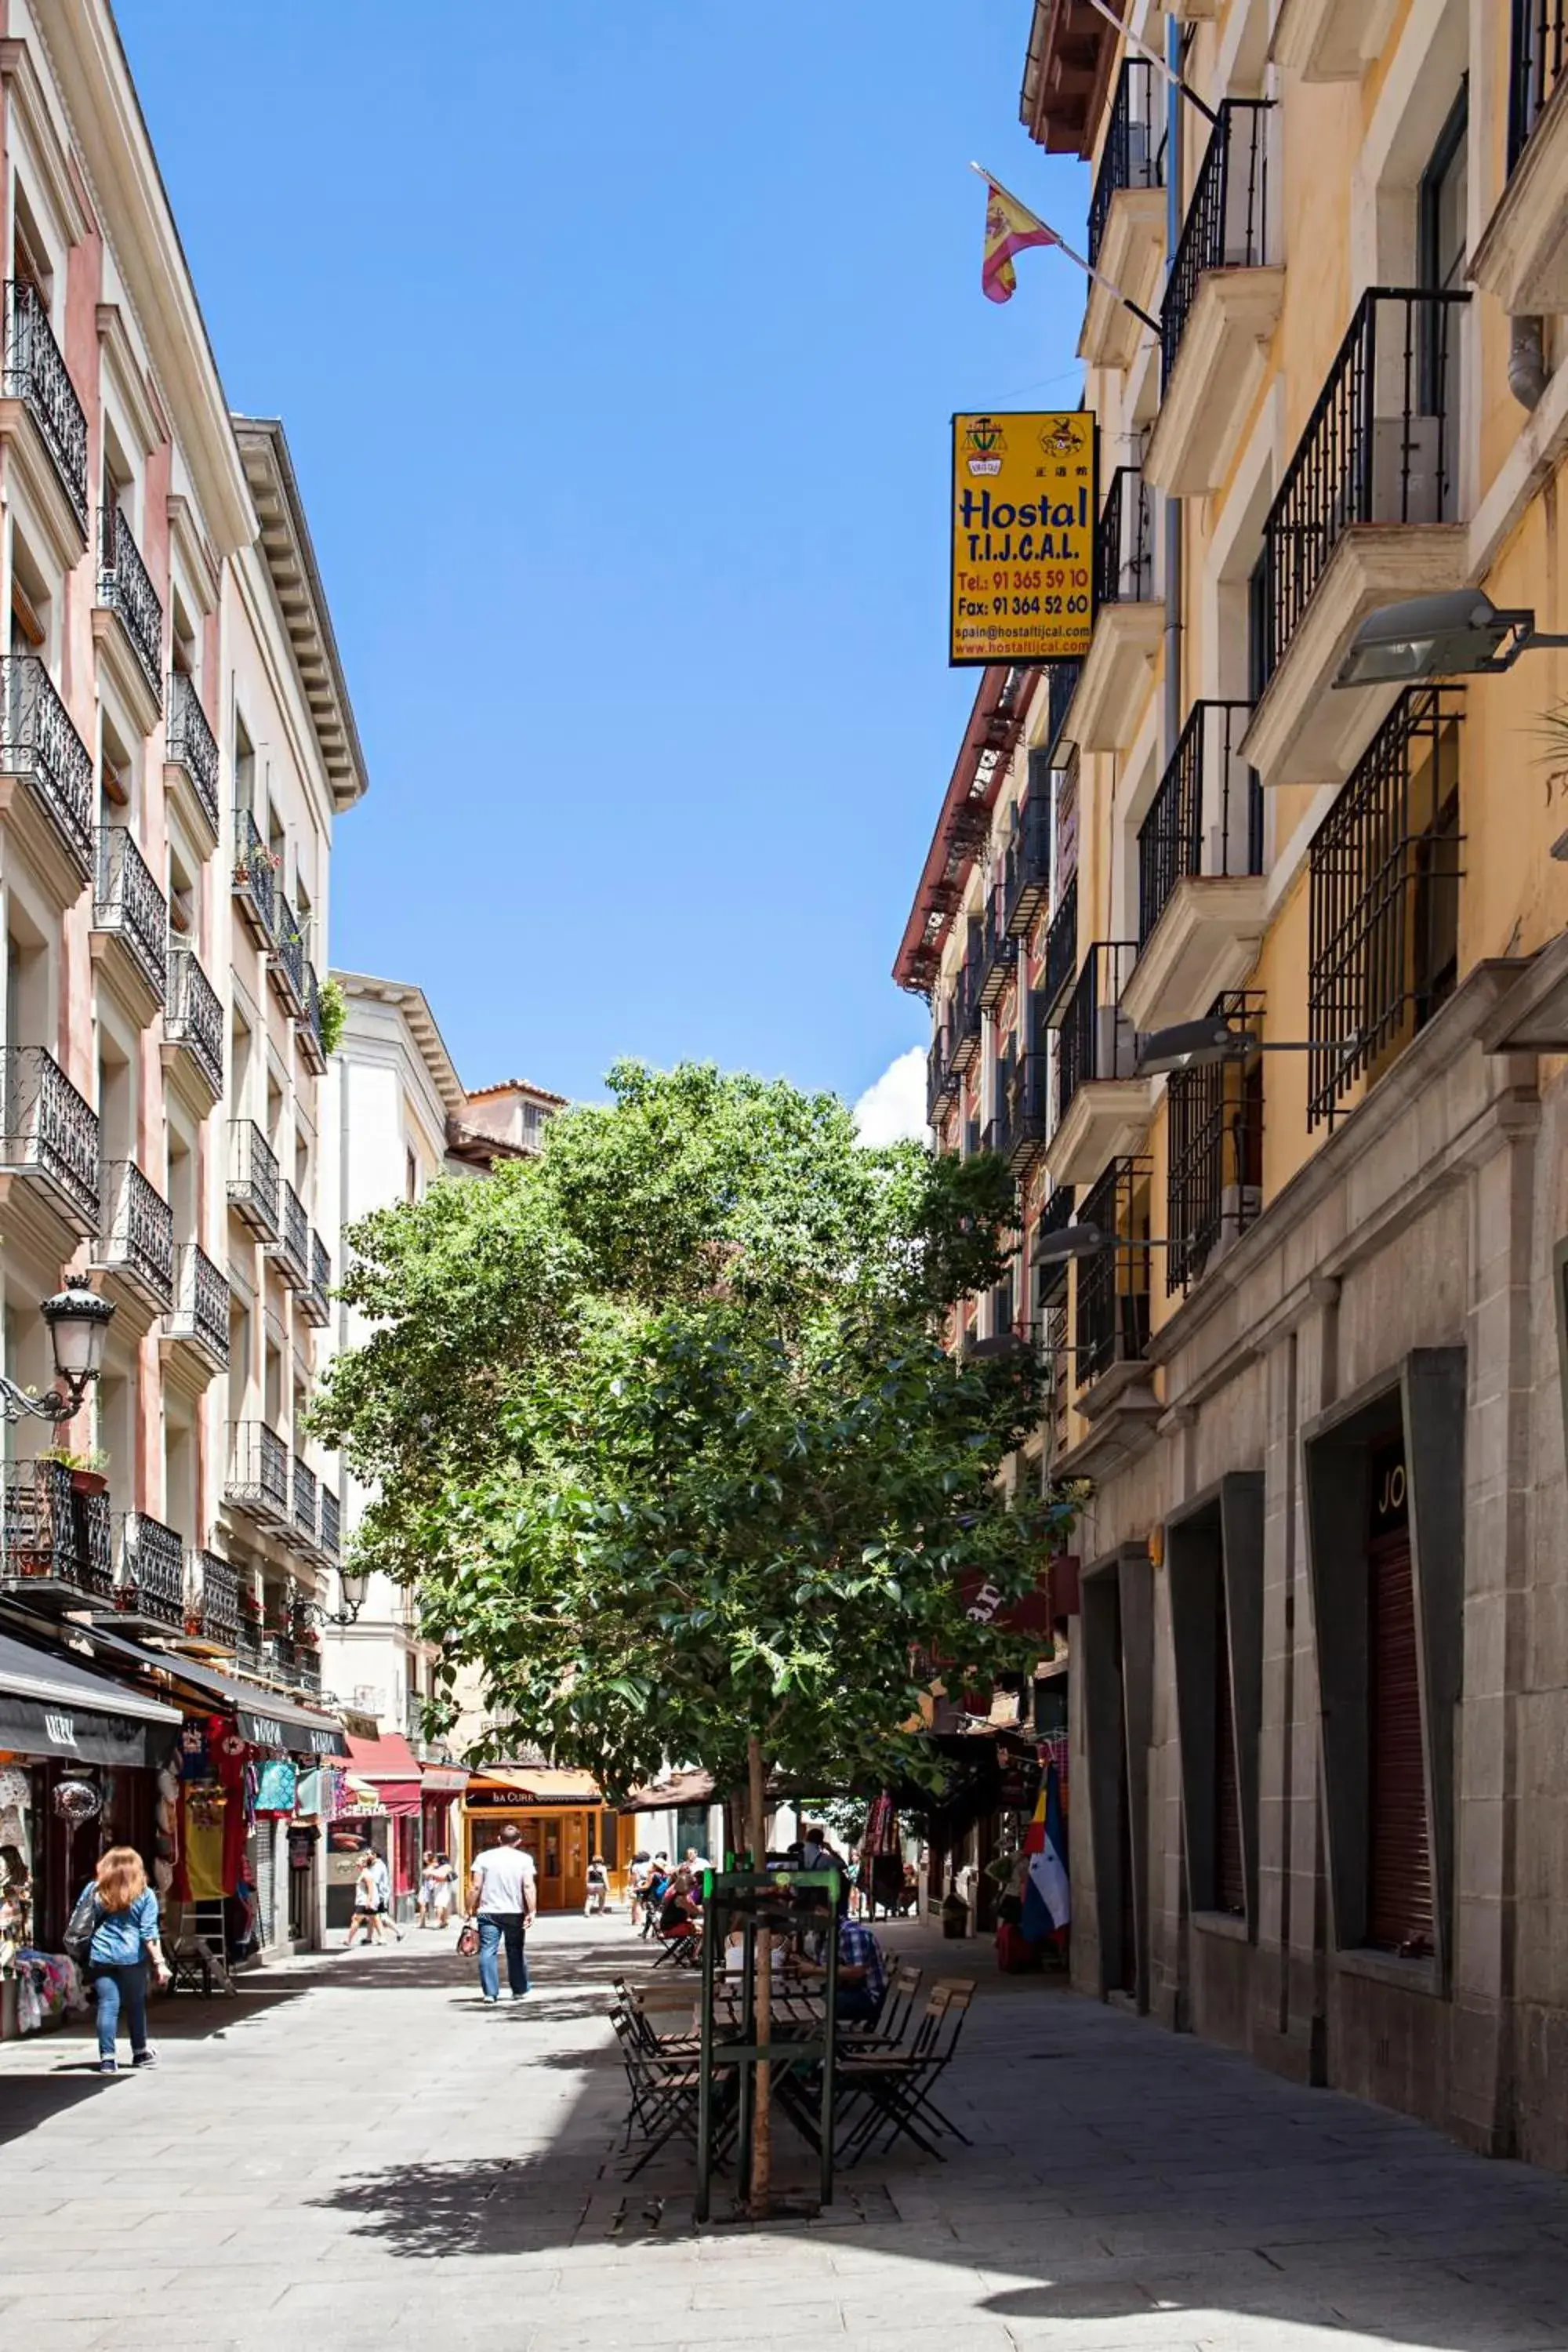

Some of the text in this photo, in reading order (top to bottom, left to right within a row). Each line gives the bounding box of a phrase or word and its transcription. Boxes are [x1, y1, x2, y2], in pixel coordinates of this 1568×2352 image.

[960, 485, 1087, 530] Hostal
[968, 533, 1080, 562] T.I.J.C.A.L.
[993, 570, 1008, 590] 91
[1014, 570, 1041, 590] 365
[1046, 569, 1065, 588] 59
[1069, 568, 1088, 587] 10
[958, 594, 1088, 617] Fax: 91 364 52 60
[955, 625, 1090, 640] spain@hostaltijcal.com
[955, 640, 1091, 654] www.hostaltijcal.com
